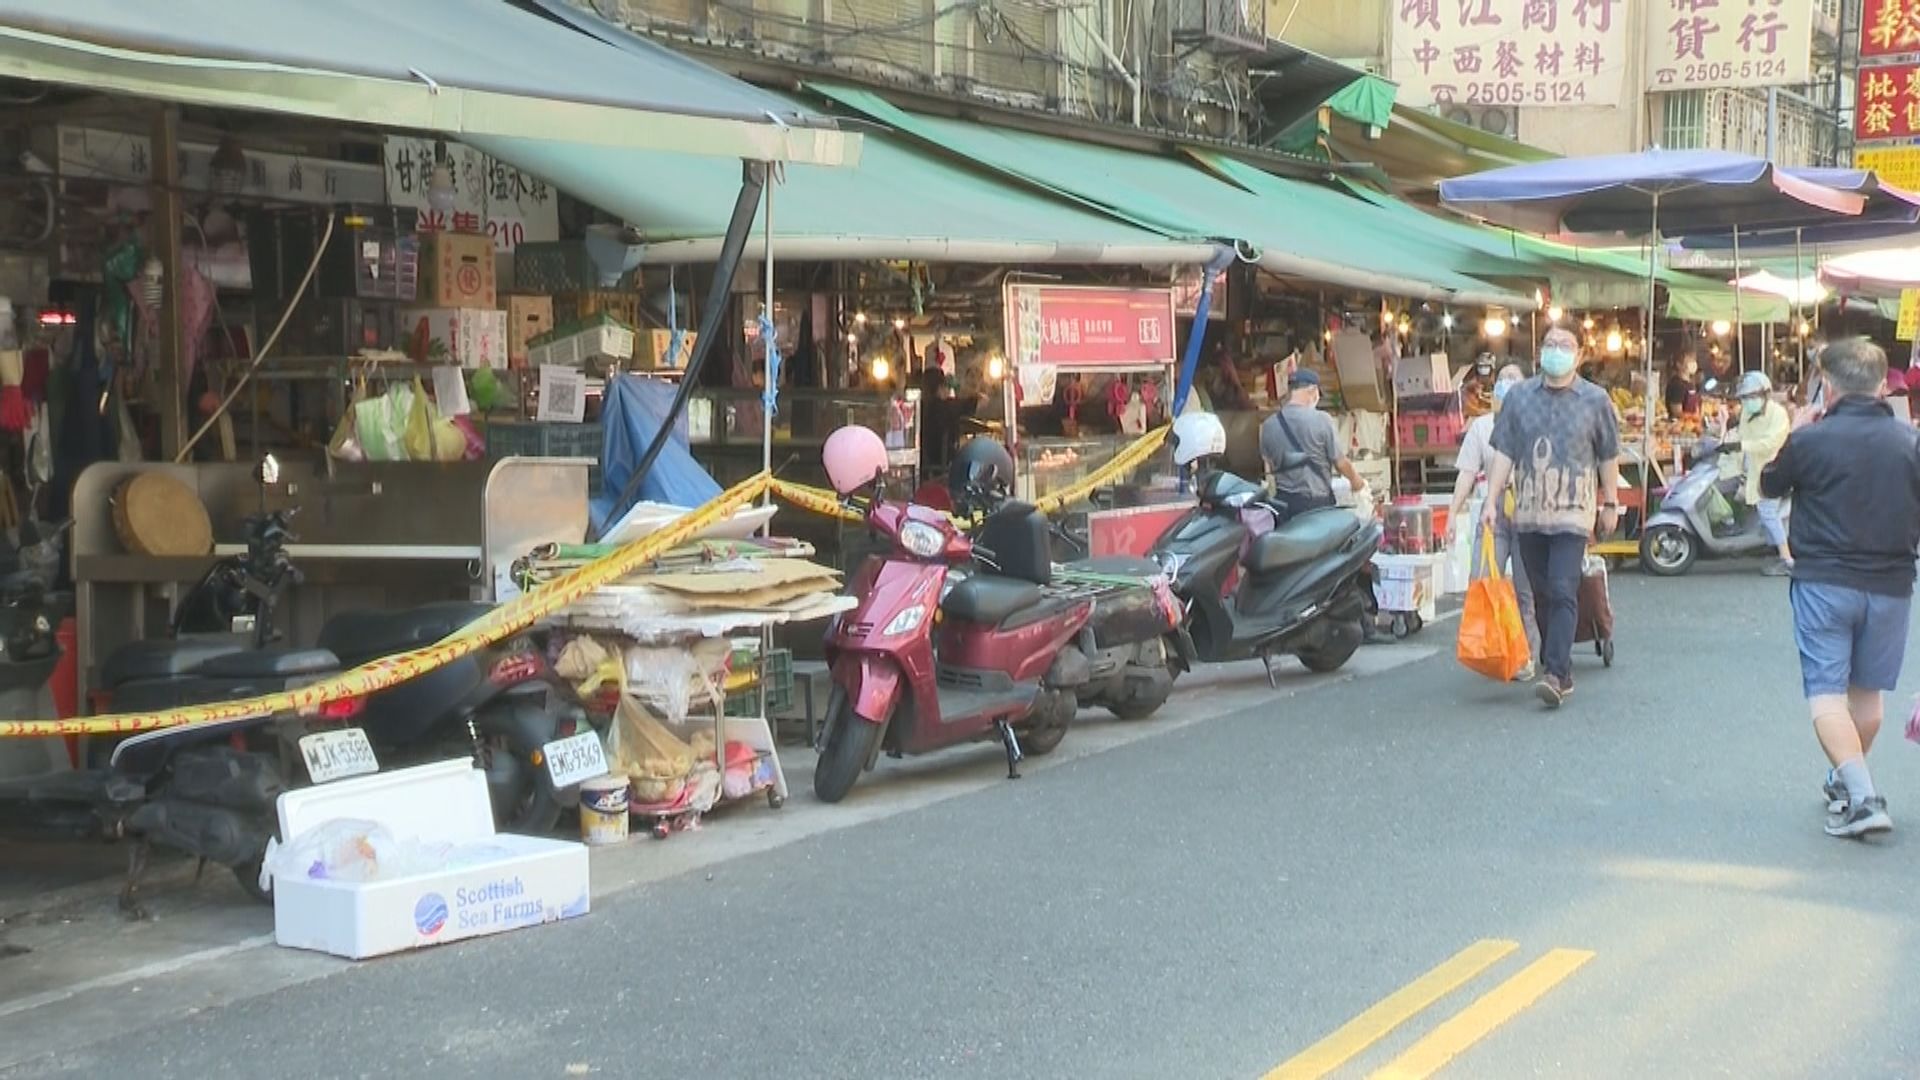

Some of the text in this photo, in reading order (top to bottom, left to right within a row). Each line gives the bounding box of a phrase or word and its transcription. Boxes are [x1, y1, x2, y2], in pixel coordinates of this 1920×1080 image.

[1413, 38, 1605, 78] 中西餐材料
[1684, 58, 1786, 83] 2505-5124
[1466, 81, 1587, 103] 2505-5124
[456, 875, 524, 907] Scottish
[458, 897, 544, 930] Sea Farms
